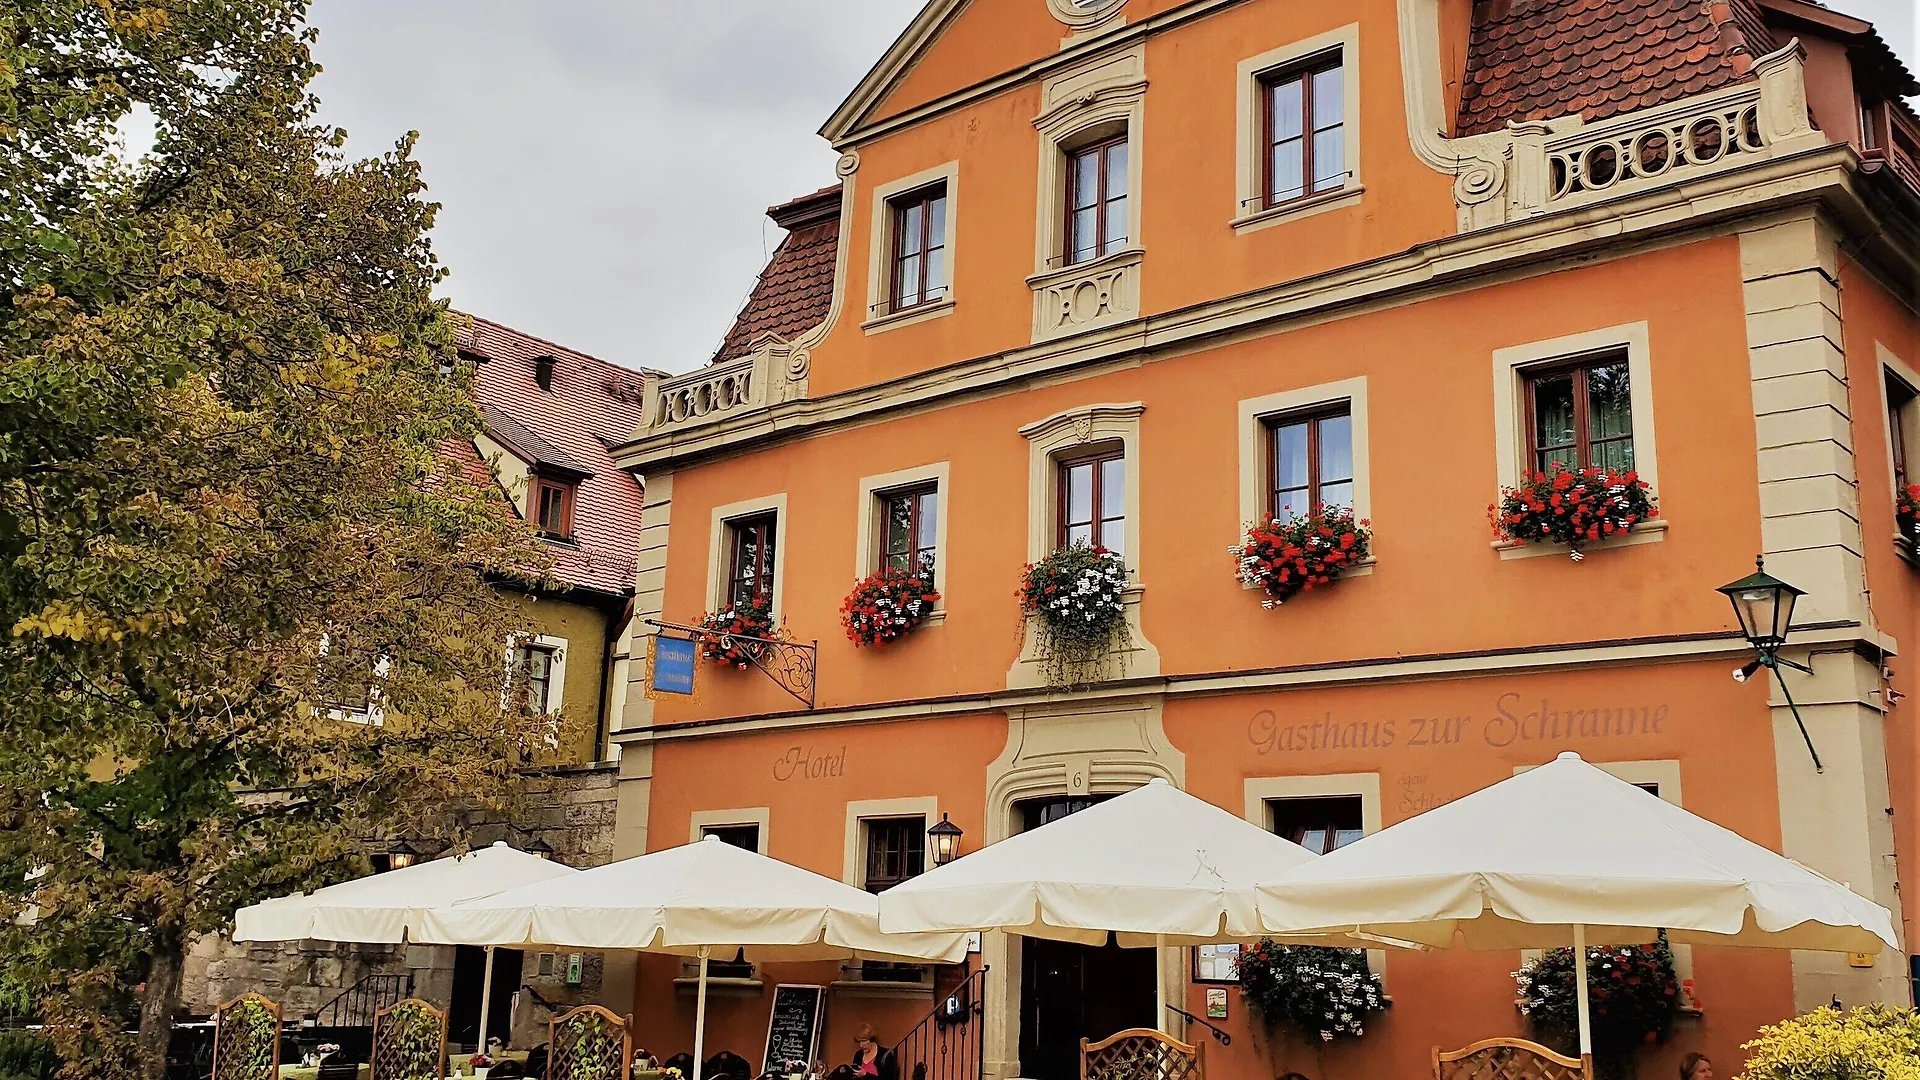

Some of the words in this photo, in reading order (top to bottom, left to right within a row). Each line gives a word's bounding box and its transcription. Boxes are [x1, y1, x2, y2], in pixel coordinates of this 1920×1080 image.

[1247, 709, 1396, 755] Gasthaus
[1408, 715, 1472, 747] zur
[1484, 692, 1669, 747] Schranne
[773, 745, 847, 782] Hotel
[1073, 771, 1082, 788] 6
